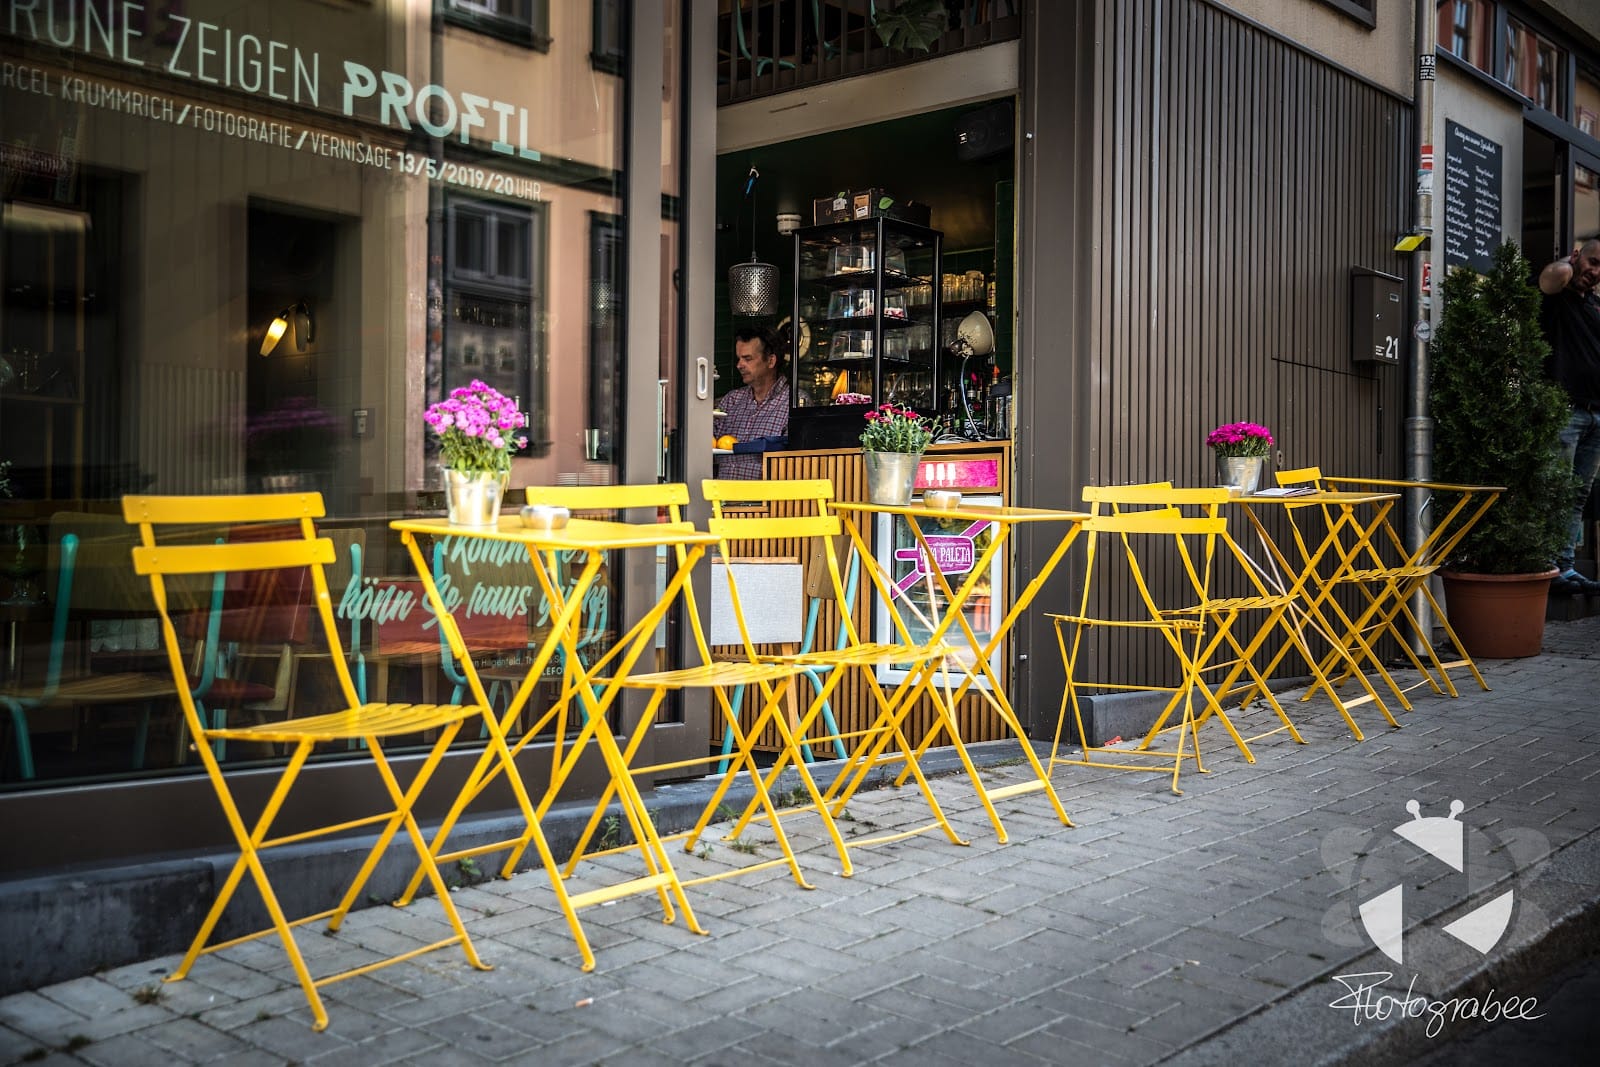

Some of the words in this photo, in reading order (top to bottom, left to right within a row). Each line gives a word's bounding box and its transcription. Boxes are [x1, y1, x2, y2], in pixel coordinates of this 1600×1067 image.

[168, 14, 319, 107] ZEIGEN
[342, 61, 541, 162] PROFIL
[516, 181, 542, 202] UHR
[1385, 335, 1399, 360] 21
[940, 547, 971, 563] PALETA
